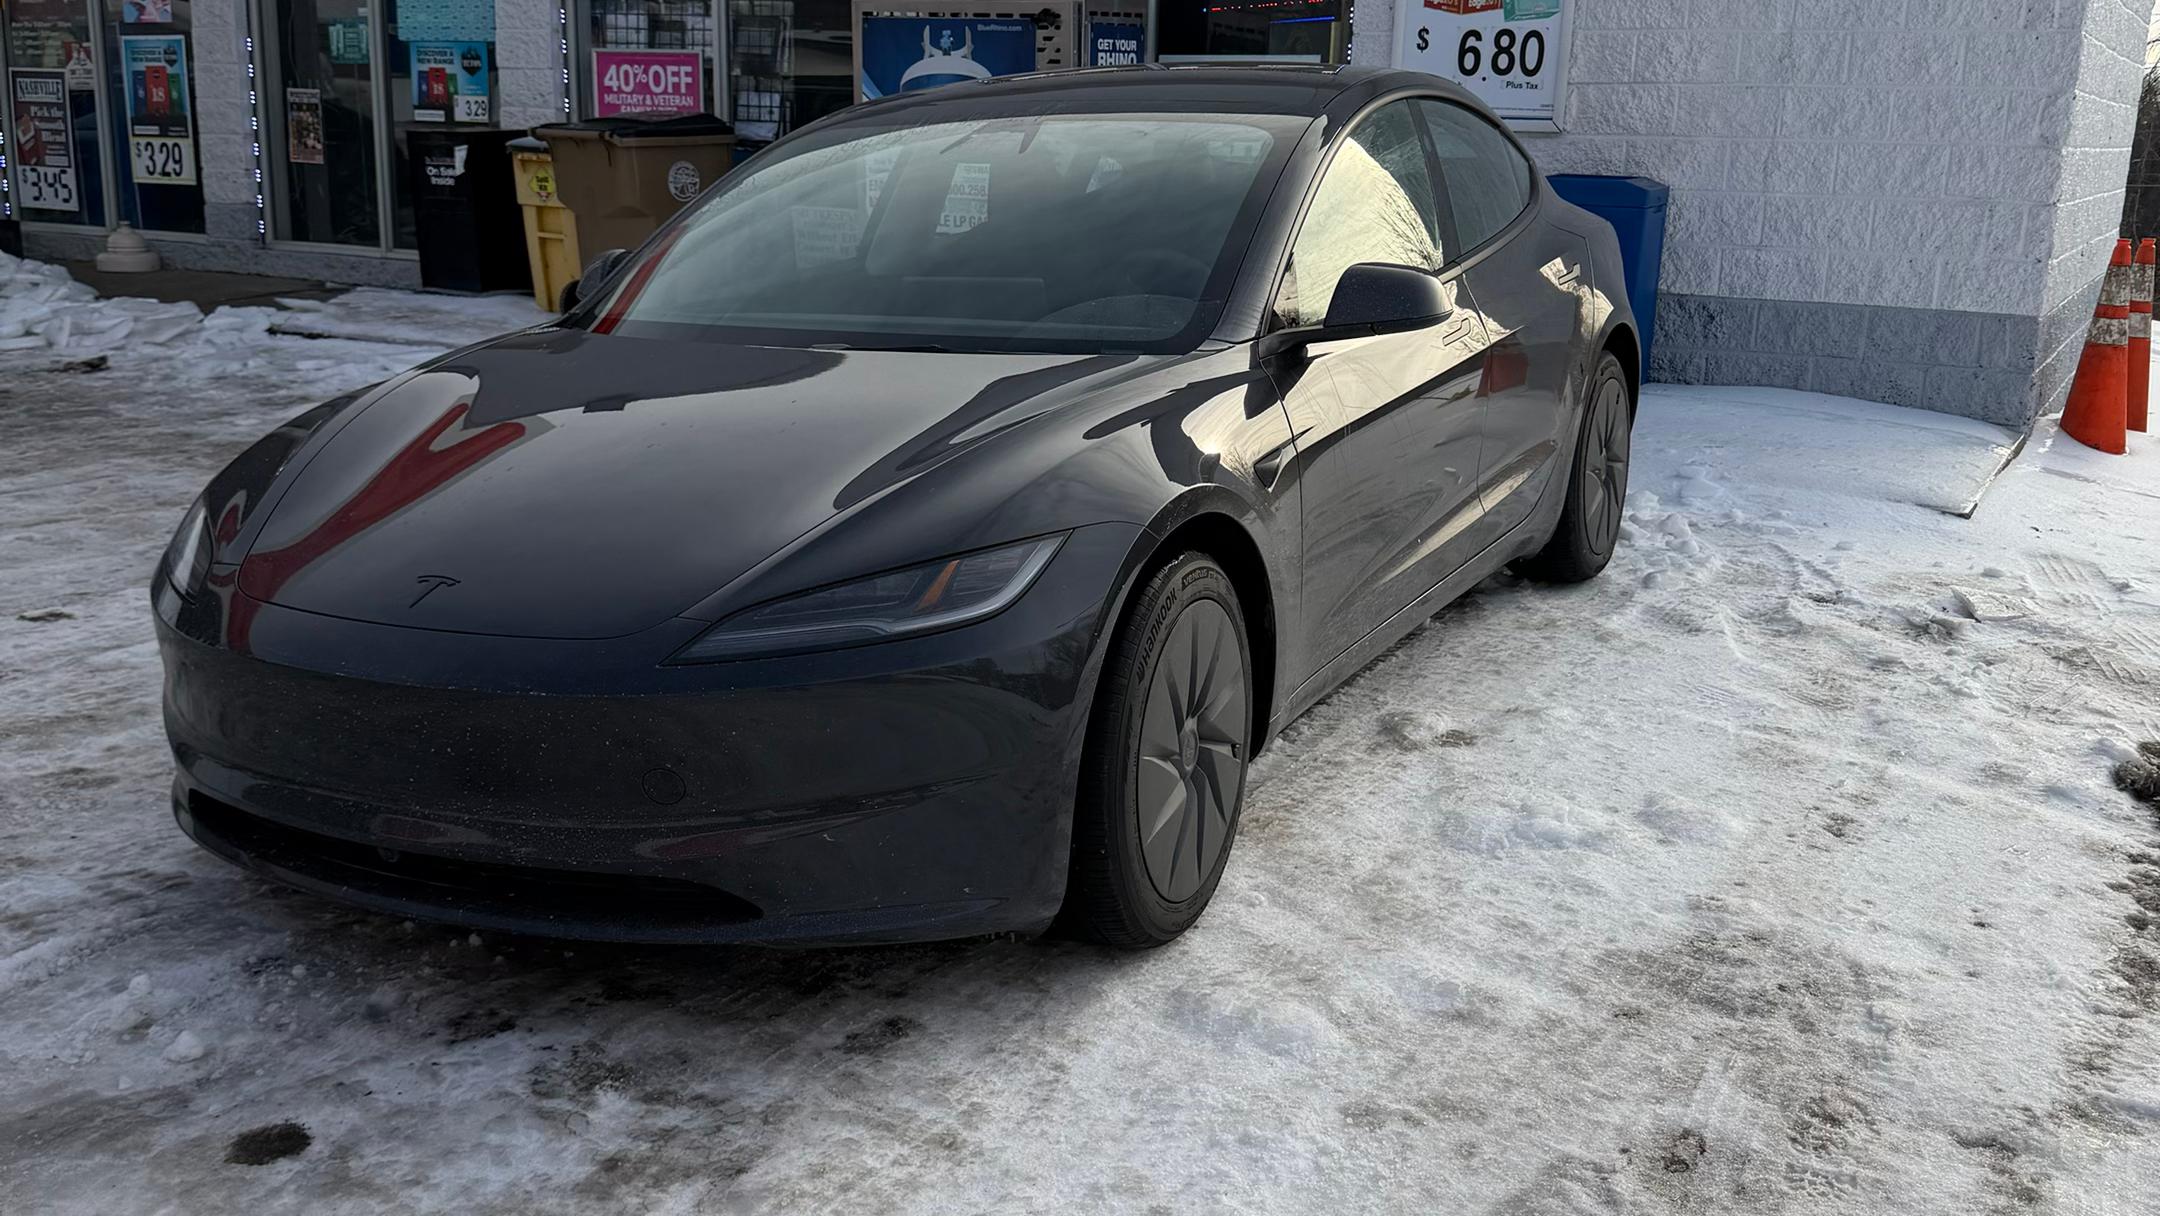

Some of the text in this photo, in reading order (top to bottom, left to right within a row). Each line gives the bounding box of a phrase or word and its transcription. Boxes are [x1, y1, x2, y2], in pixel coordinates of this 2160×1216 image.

[976, 23, 1022, 32] BlueRhino.com
[1097, 38, 1137, 52] GET YOUR
[1097, 52, 1137, 66] RHINO
[1416, 26, 1545, 82] $ 6.80
[648, 64, 693, 94] OFF
[1505, 81, 1523, 89] Plus
[18, 79, 62, 101] NASHVILLE
[603, 93, 694, 107] MILITARY & VETERAN
[426, 166, 440, 176] On
[430, 176, 456, 186] Inside
[953, 215, 967, 228] LP
